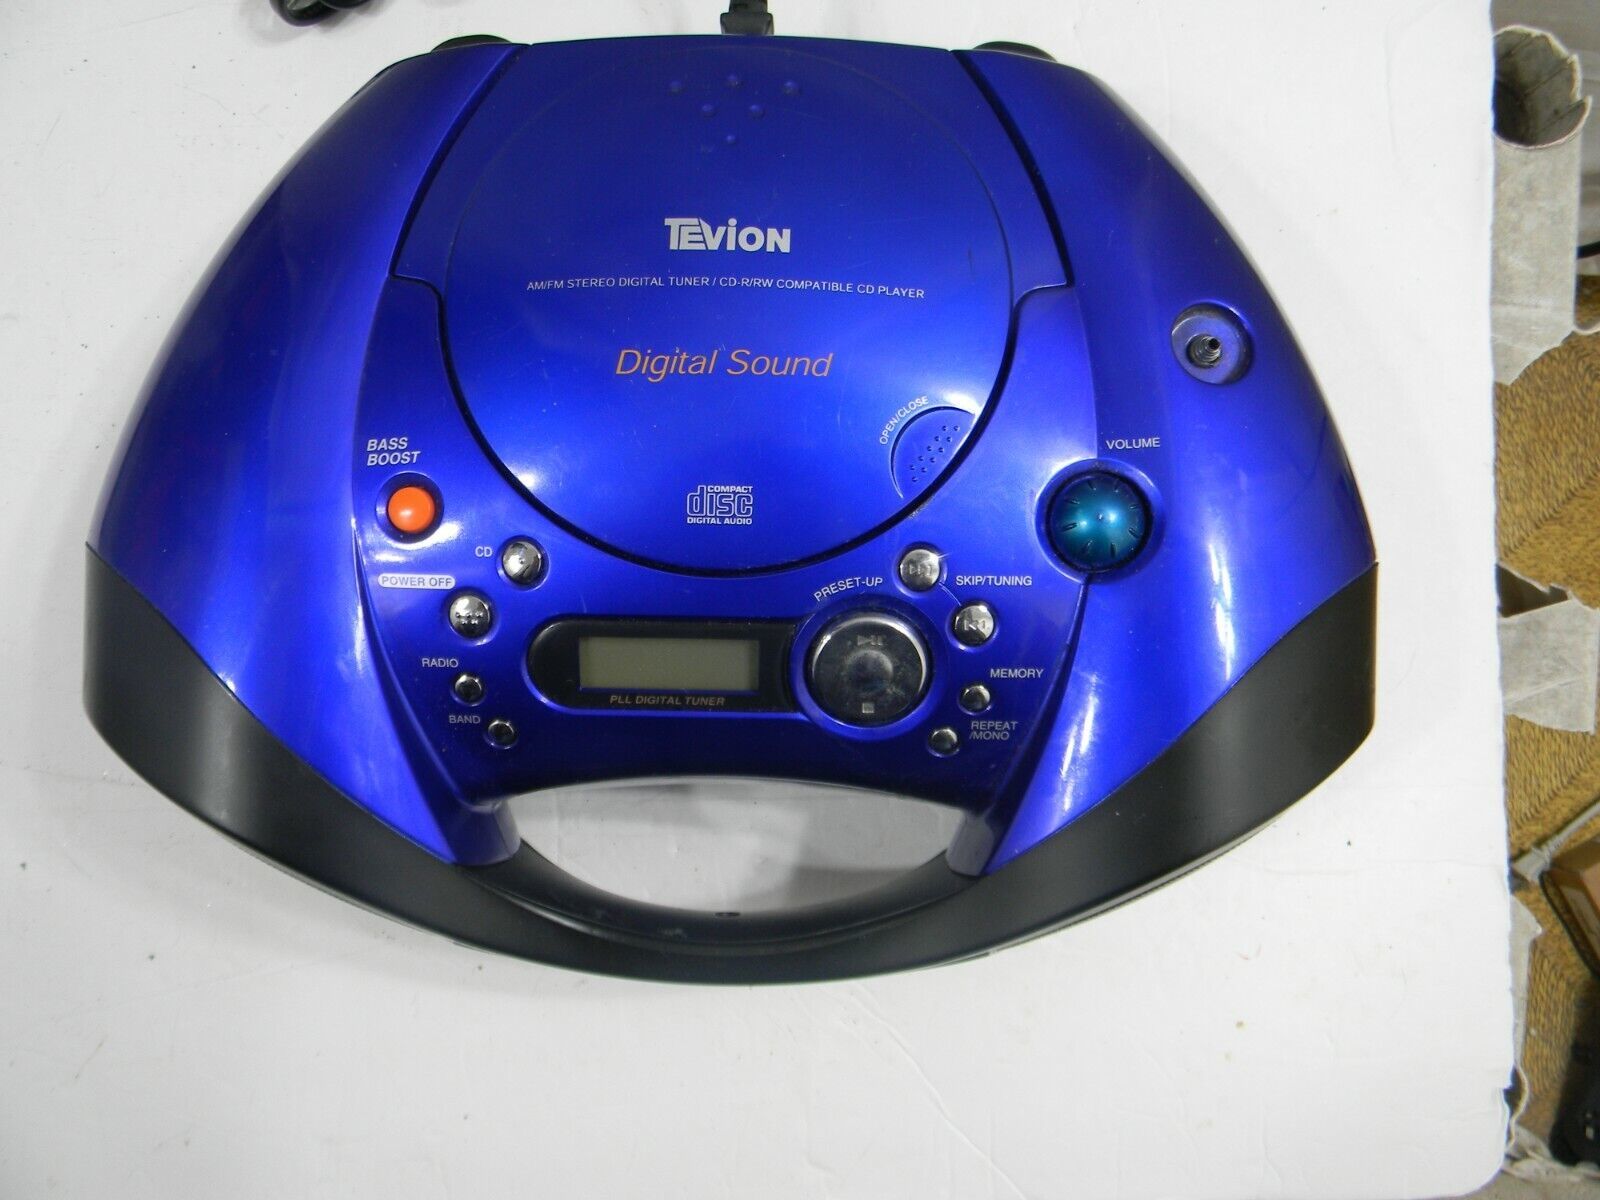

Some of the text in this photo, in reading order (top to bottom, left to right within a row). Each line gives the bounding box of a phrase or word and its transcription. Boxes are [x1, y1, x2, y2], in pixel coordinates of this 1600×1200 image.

[527, 279, 564, 291] AM/FM
[567, 278, 616, 289] STEREO
[619, 276, 664, 287] DIGITAL
[668, 276, 709, 287] TUNER
[719, 277, 774, 289] CD-R/RW
[776, 278, 853, 294] COMPATIBLE
[857, 283, 874, 295] CD
[877, 285, 925, 299] PLAYER
[615, 348, 834, 383] Digital Sound
[879, 395, 929, 446] OPEN/CLOSE
[367, 437, 408, 452] BASS
[1105, 437, 1161, 450] VOLUME
[366, 450, 421, 466] BOOST
[707, 485, 753, 493] COMPACT
[686, 485, 753, 516] disc
[686, 517, 752, 525] DIGITAL AUDIO
[475, 545, 493, 558] CD
[381, 575, 453, 588] POWER OFF
[955, 574, 1033, 587] SKIP/TUNING
[813, 576, 884, 602] PRESET-UP
[422, 657, 459, 669] RADIO
[990, 668, 1044, 679] MEMORY
[610, 695, 726, 707] PLL DIGITAL TUNER
[449, 714, 481, 725] BAND
[971, 720, 1018, 731] REPEAT
[969, 730, 1010, 741] /MONO
